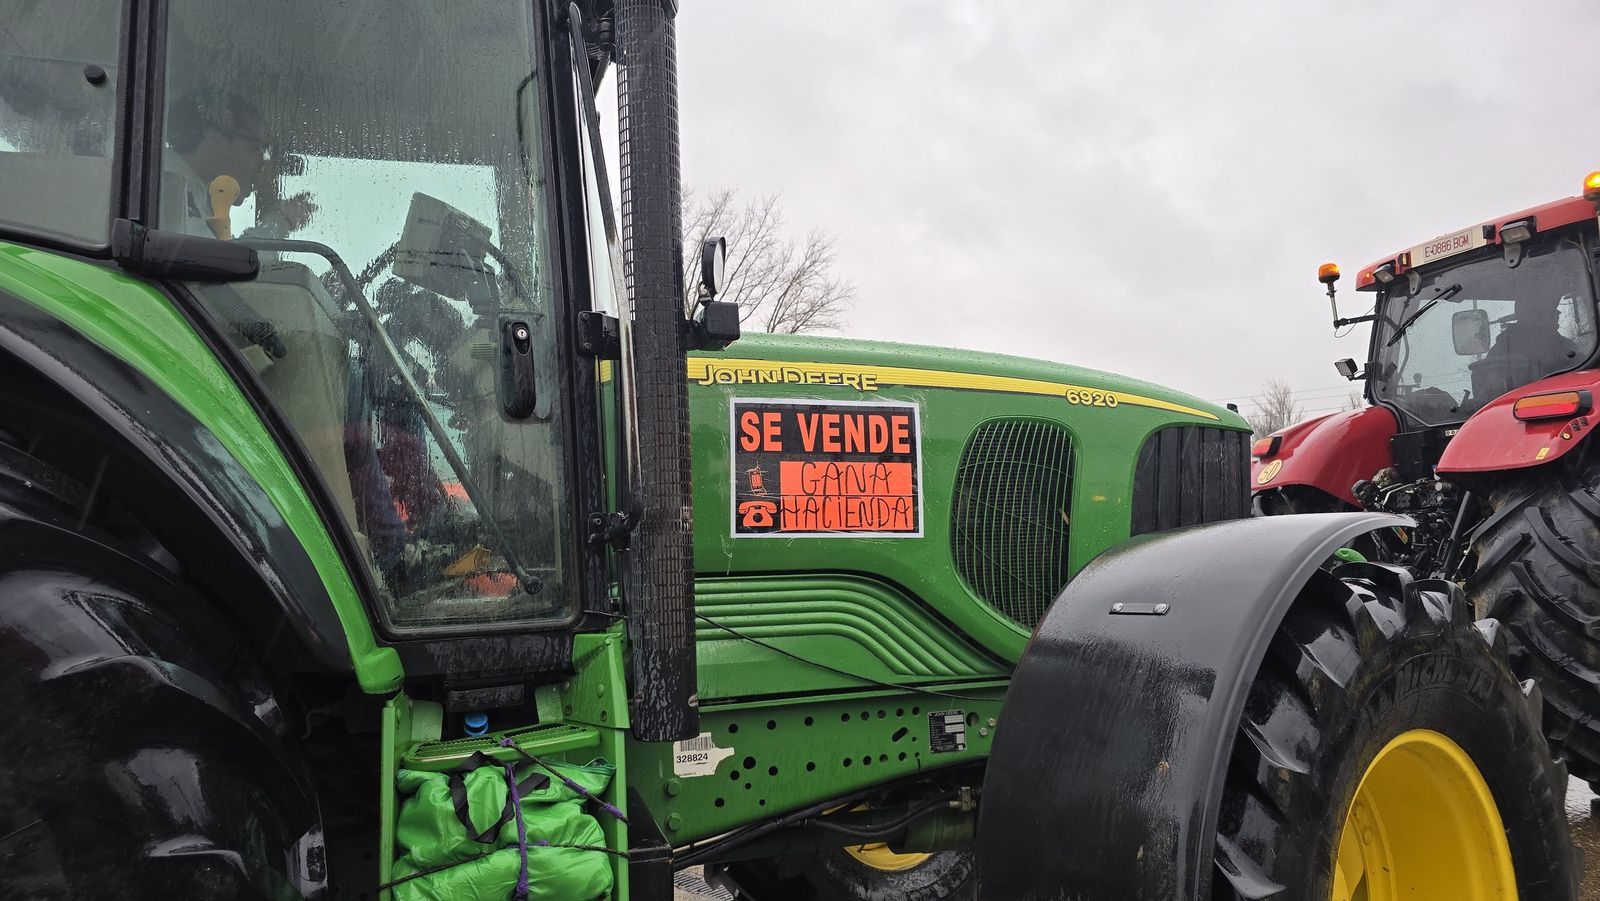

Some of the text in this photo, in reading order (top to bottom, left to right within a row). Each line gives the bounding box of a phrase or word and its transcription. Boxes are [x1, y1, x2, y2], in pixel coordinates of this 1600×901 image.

[1425, 233, 1469, 258] E-0886 BGM
[698, 364, 878, 392] JOHN DEERE
[1065, 389, 1119, 408] 6920
[740, 411, 911, 454] SE VENDE
[801, 462, 892, 496] GANA
[676, 752, 709, 763] 328824
